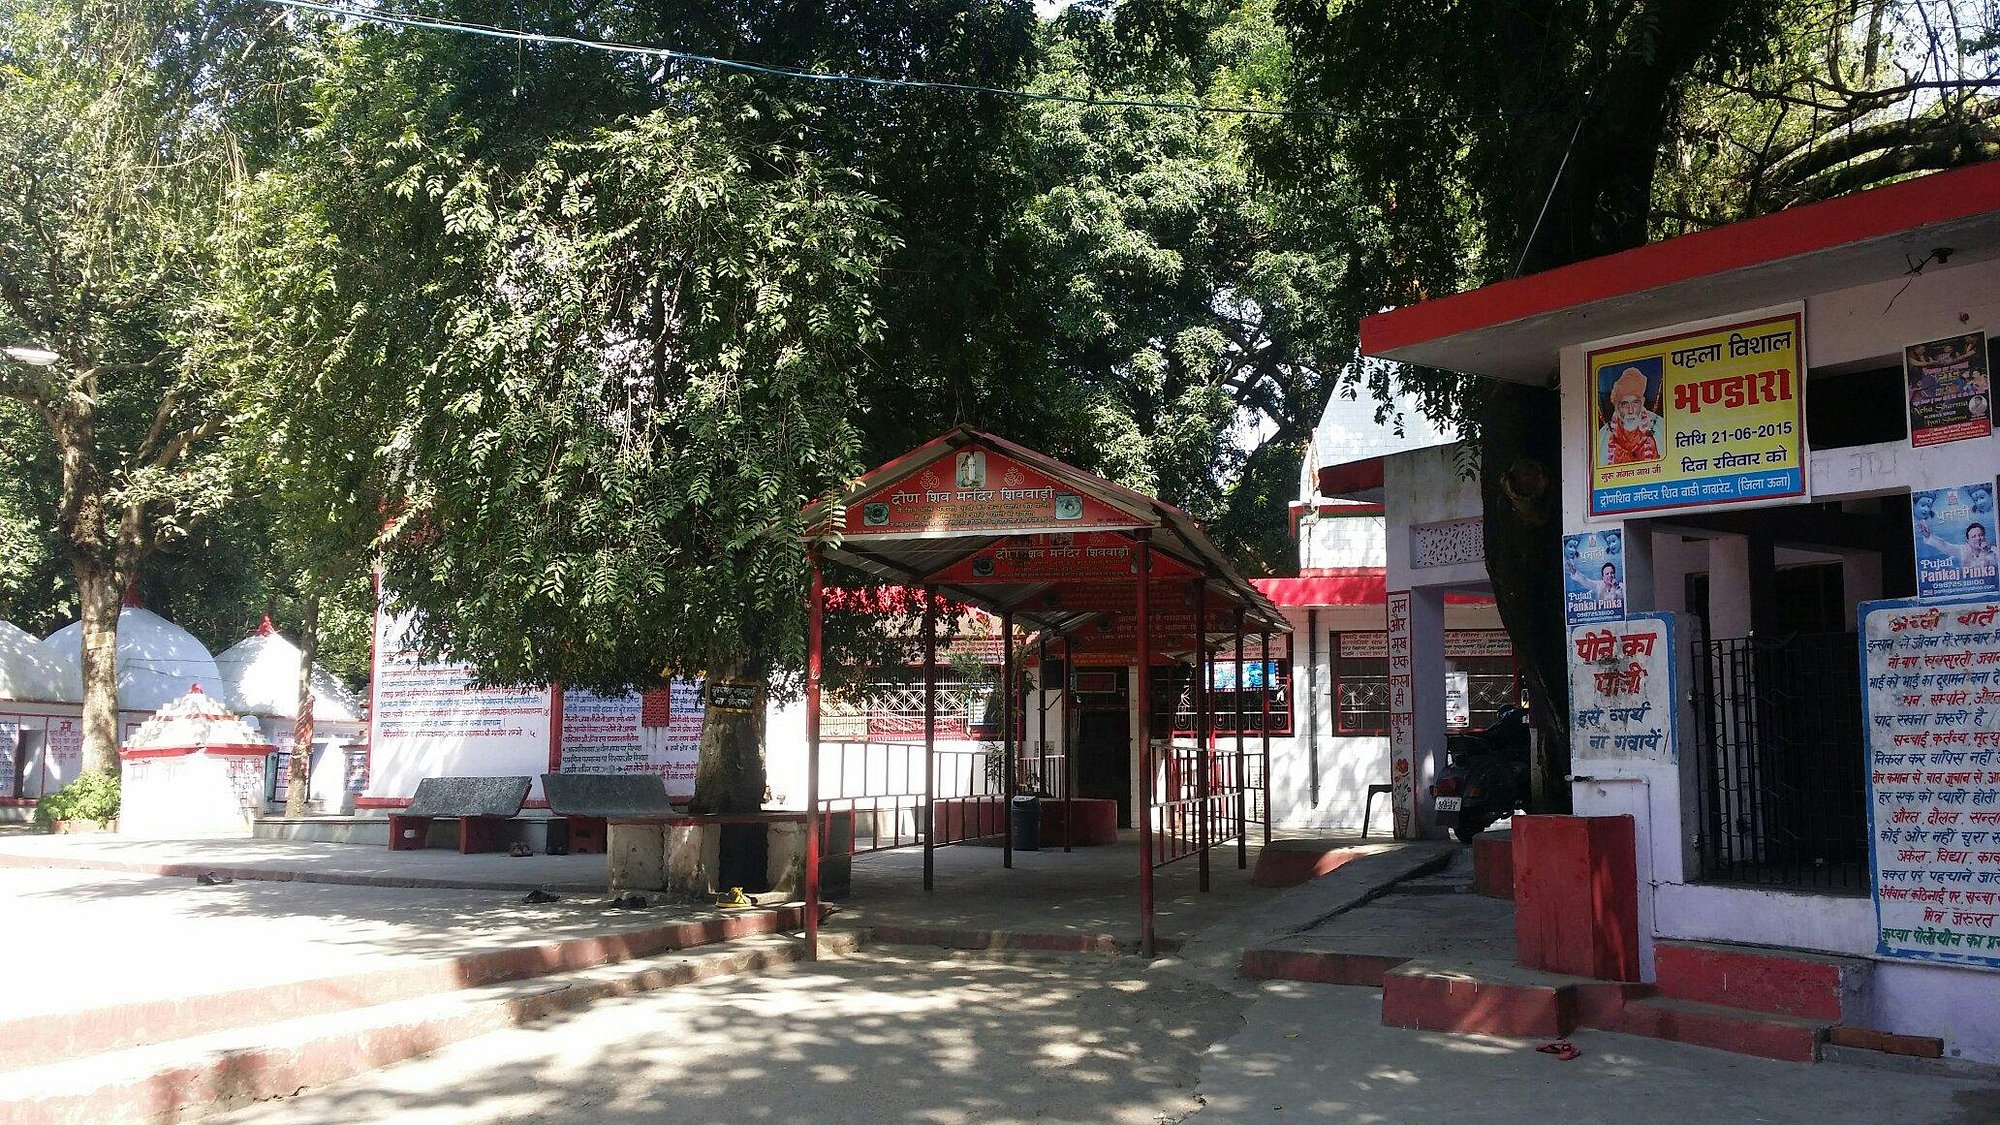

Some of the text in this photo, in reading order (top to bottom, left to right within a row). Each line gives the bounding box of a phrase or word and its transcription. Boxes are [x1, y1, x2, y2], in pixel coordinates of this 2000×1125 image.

[1671, 331, 1792, 368] पहला विशाल
[1674, 368, 1793, 414] भण्डारा
[1675, 421, 1792, 448] तिथि 21-06-2015
[1681, 444, 1788, 473] दिन रविवार को
[1651, 464, 1662, 474] जी
[926, 489, 950, 503] शिव
[1661, 485, 1678, 500] शिव
[1922, 565, 1996, 583] Pankaj Pinka
[1391, 599, 1407, 613] मन
[1568, 598, 1622, 612] Pankaj Pinka
[1389, 613, 1407, 632] और
[1575, 629, 1657, 663] पीने का
[1867, 640, 1894, 654] इन्सान
[1912, 634, 1942, 650] जीवन
[1973, 632, 1992, 647] बार
[1392, 656, 1409, 669] एक
[1594, 662, 1648, 697] पानी
[1869, 674, 1886, 690] भाई
[1887, 673, 1902, 688] को
[1902, 673, 1920, 689] भाई
[1922, 674, 1936, 687] का
[1971, 671, 1991, 684] बना
[1578, 701, 1651, 726] इसे व्यर्थ
[1874, 715, 1895, 727] याद
[1898, 714, 1932, 726] रखना
[1974, 706, 1988, 726] है
[1590, 728, 1662, 752] ना गवायें
[1894, 731, 1930, 748] सच्चाई
[1874, 751, 1906, 766] निकल
[1909, 754, 1927, 766] कर
[1930, 750, 1967, 766] वापिस
[1970, 749, 1995, 766] नहीं
[1887, 772, 1911, 784] कमान
[1912, 769, 1923, 784] से
[1973, 769, 1983, 784] से
[1878, 788, 2000, 805] हर एक को प्यारी होती
[1891, 806, 1922, 824] औरत
[1927, 806, 1963, 825] दौलत
[1881, 827, 1902, 844] कोई
[1905, 826, 1930, 842] और
[1932, 828, 1958, 845] नहीं
[1962, 831, 1989, 847] चुरा
[1937, 847, 1973, 864] विद्या
[1882, 870, 1909, 882] वक्त
[1910, 870, 1926, 882] पर
[1929, 868, 1974, 884] पहचाने
[1949, 890, 1961, 902] पर
[1966, 933, 1987, 948] का
